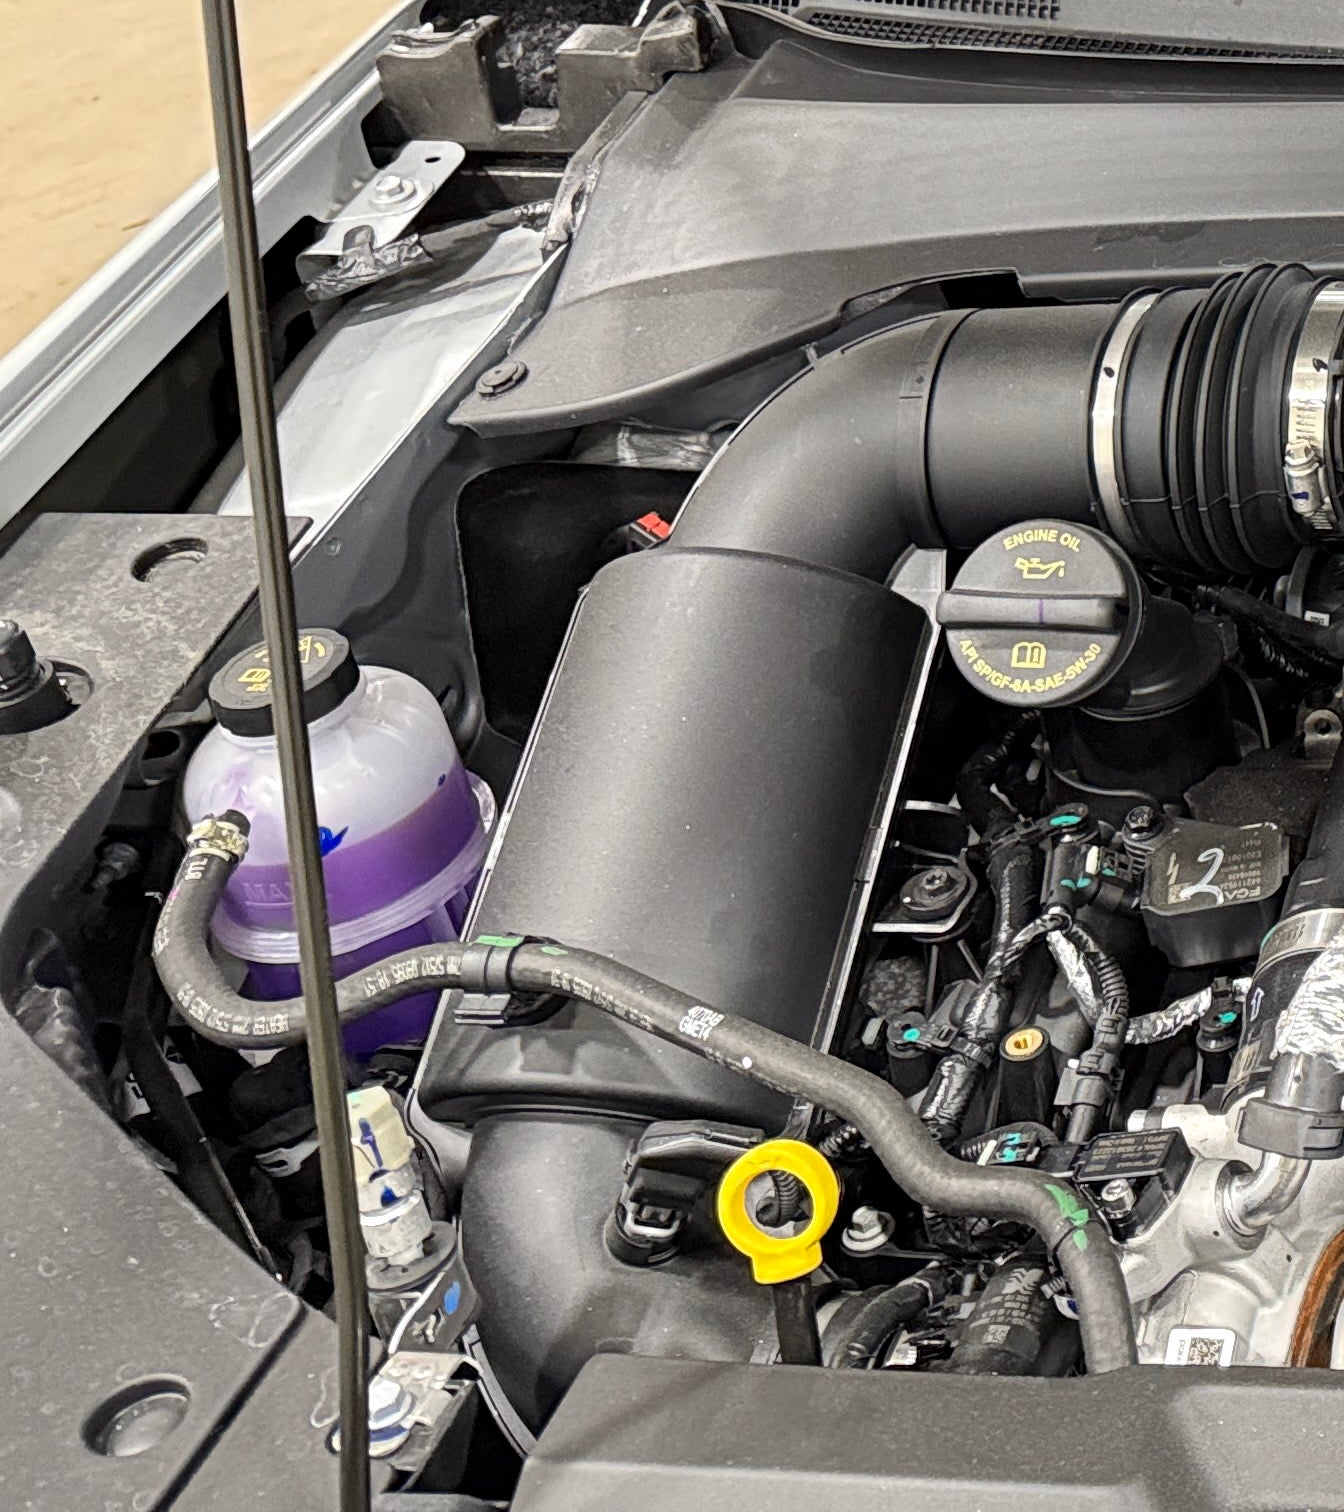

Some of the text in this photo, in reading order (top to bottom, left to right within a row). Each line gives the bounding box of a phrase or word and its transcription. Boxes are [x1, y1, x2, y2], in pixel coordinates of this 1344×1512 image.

[1003, 529, 1081, 552] ENGINE OIL
[959, 639, 975, 665] API
